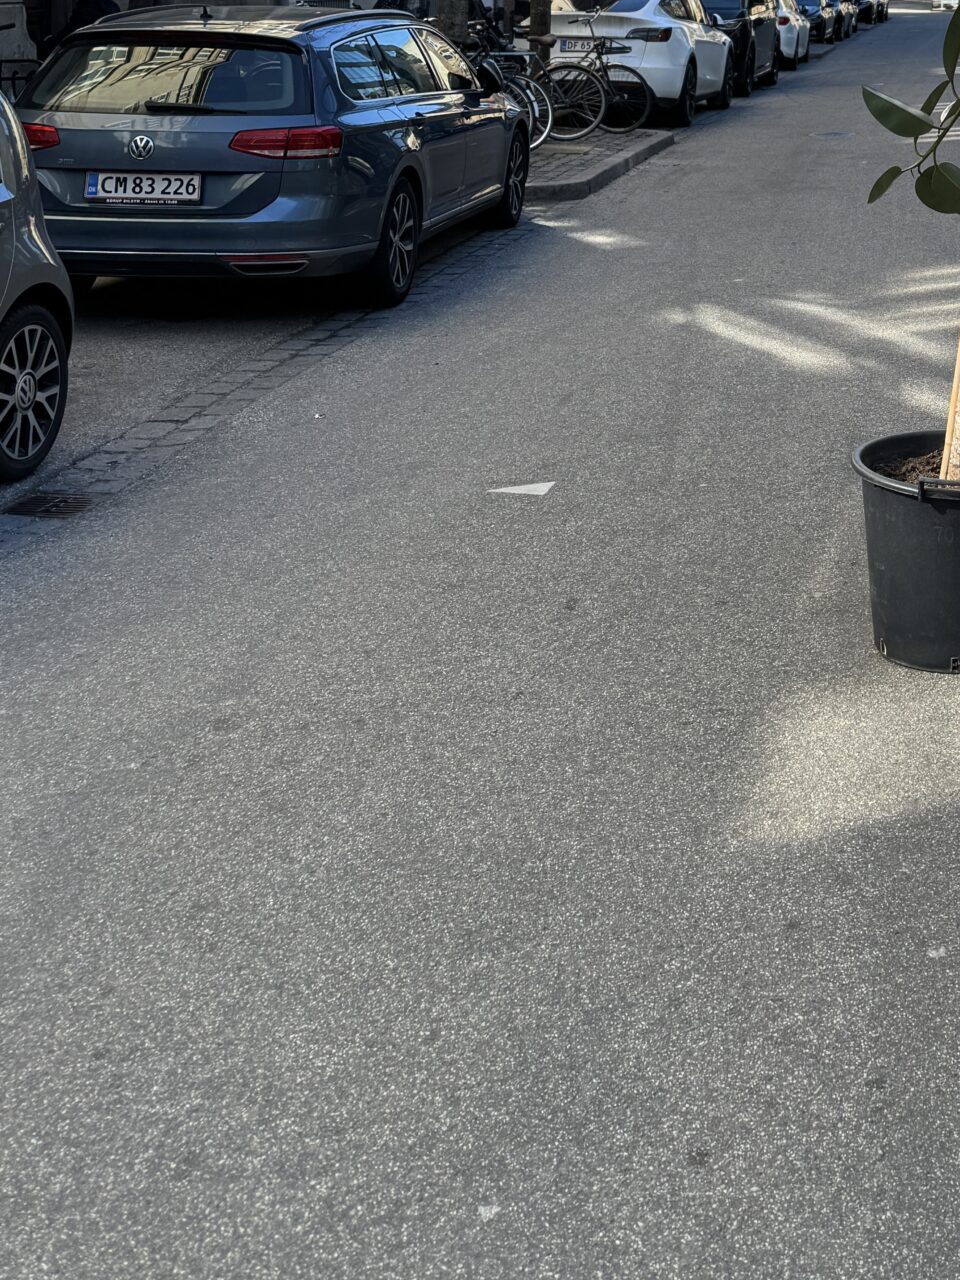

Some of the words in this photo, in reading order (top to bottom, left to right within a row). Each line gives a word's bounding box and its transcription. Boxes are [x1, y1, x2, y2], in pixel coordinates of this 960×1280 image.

[567, 41, 579, 49] DF
[580, 41, 592, 50] 65
[101, 176, 128, 194] CM
[132, 176, 156, 195] 83
[160, 177, 197, 196] 226
